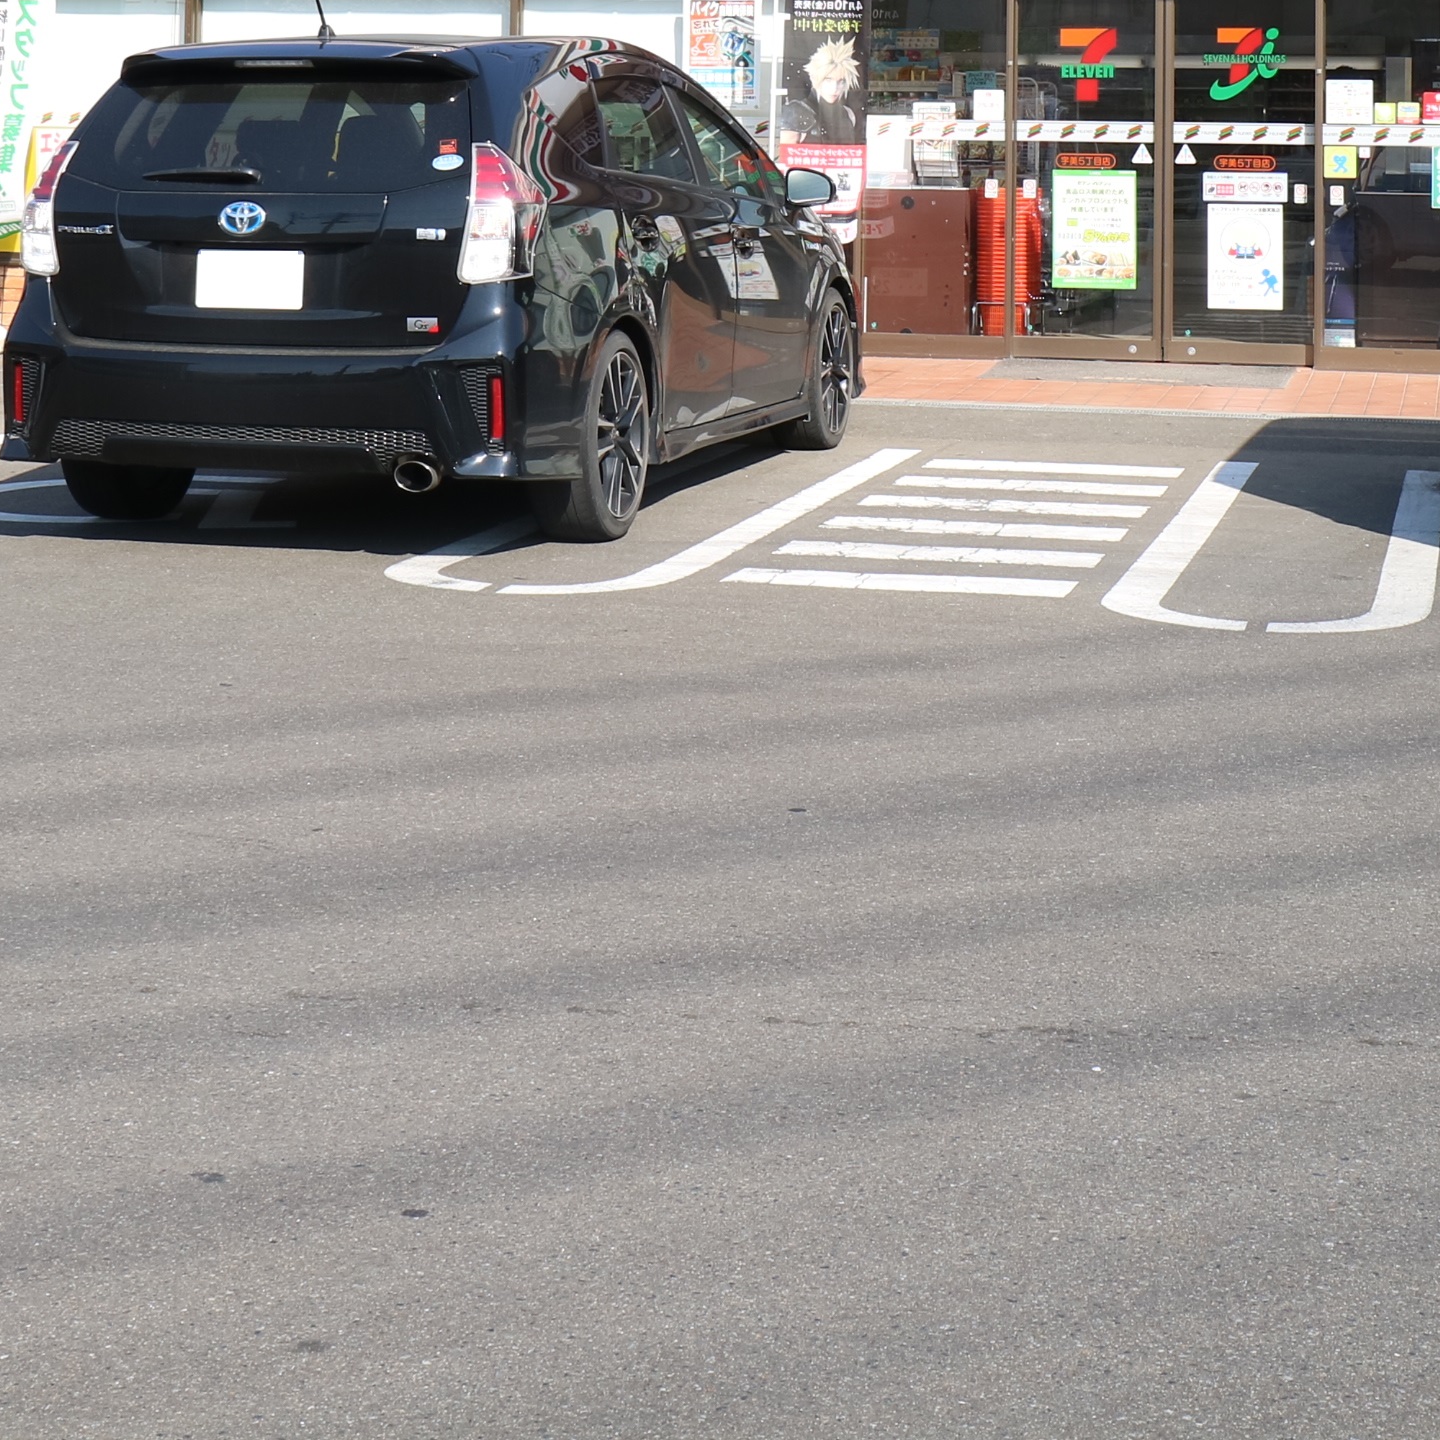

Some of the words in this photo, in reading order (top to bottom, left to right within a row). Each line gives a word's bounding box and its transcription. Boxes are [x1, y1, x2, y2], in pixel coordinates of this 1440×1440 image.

[691, 1, 719, 16] バイク
[1242, 54, 1287, 64] HOLDINGS
[1060, 156, 1111, 166] 宇美5丁目店
[1219, 158, 1271, 168] 宇美5丁目店
